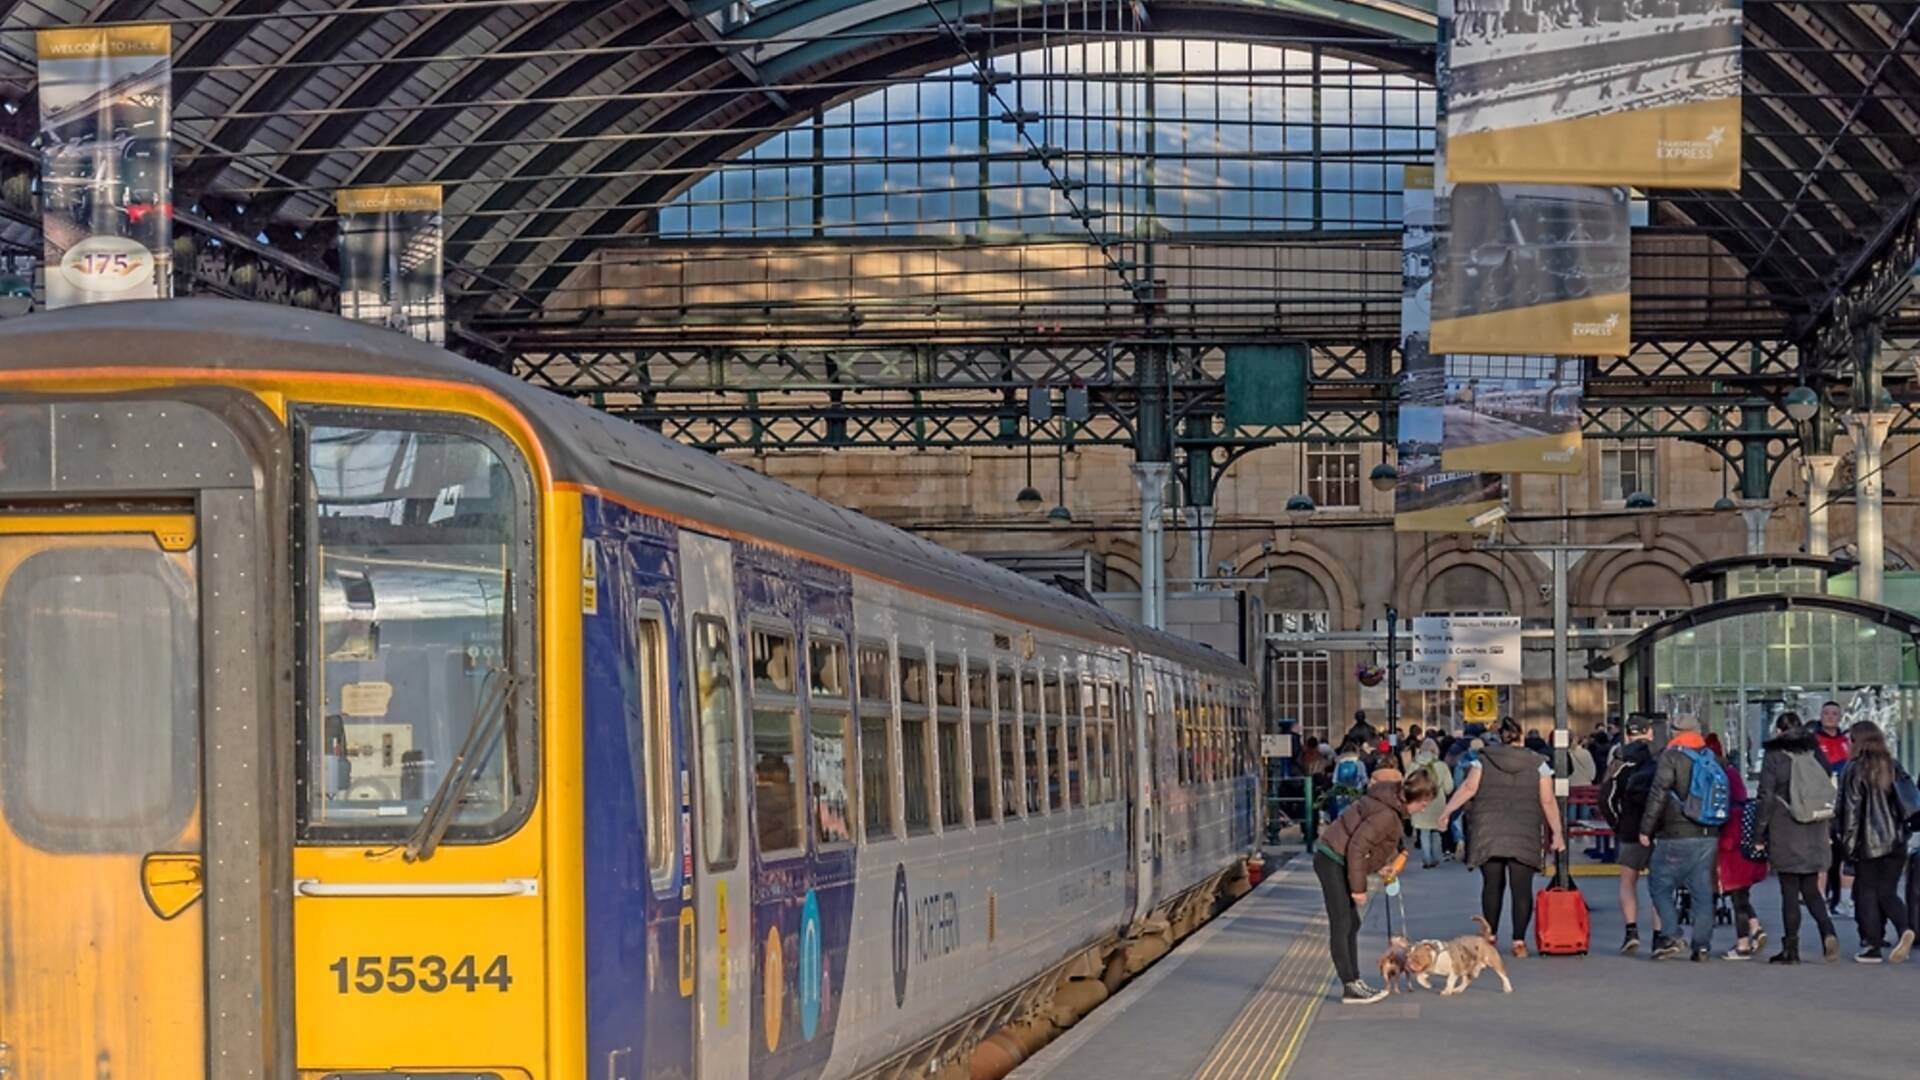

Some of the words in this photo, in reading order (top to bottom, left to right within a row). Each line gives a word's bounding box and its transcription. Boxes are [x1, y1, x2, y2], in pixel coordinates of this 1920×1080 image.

[110, 41, 125, 52] TO
[1657, 147, 1713, 159] EXPRESS
[84, 254, 127, 274] 175
[1419, 665, 1440, 674] Way
[1419, 676, 1436, 685] out
[329, 955, 513, 994] 155344
